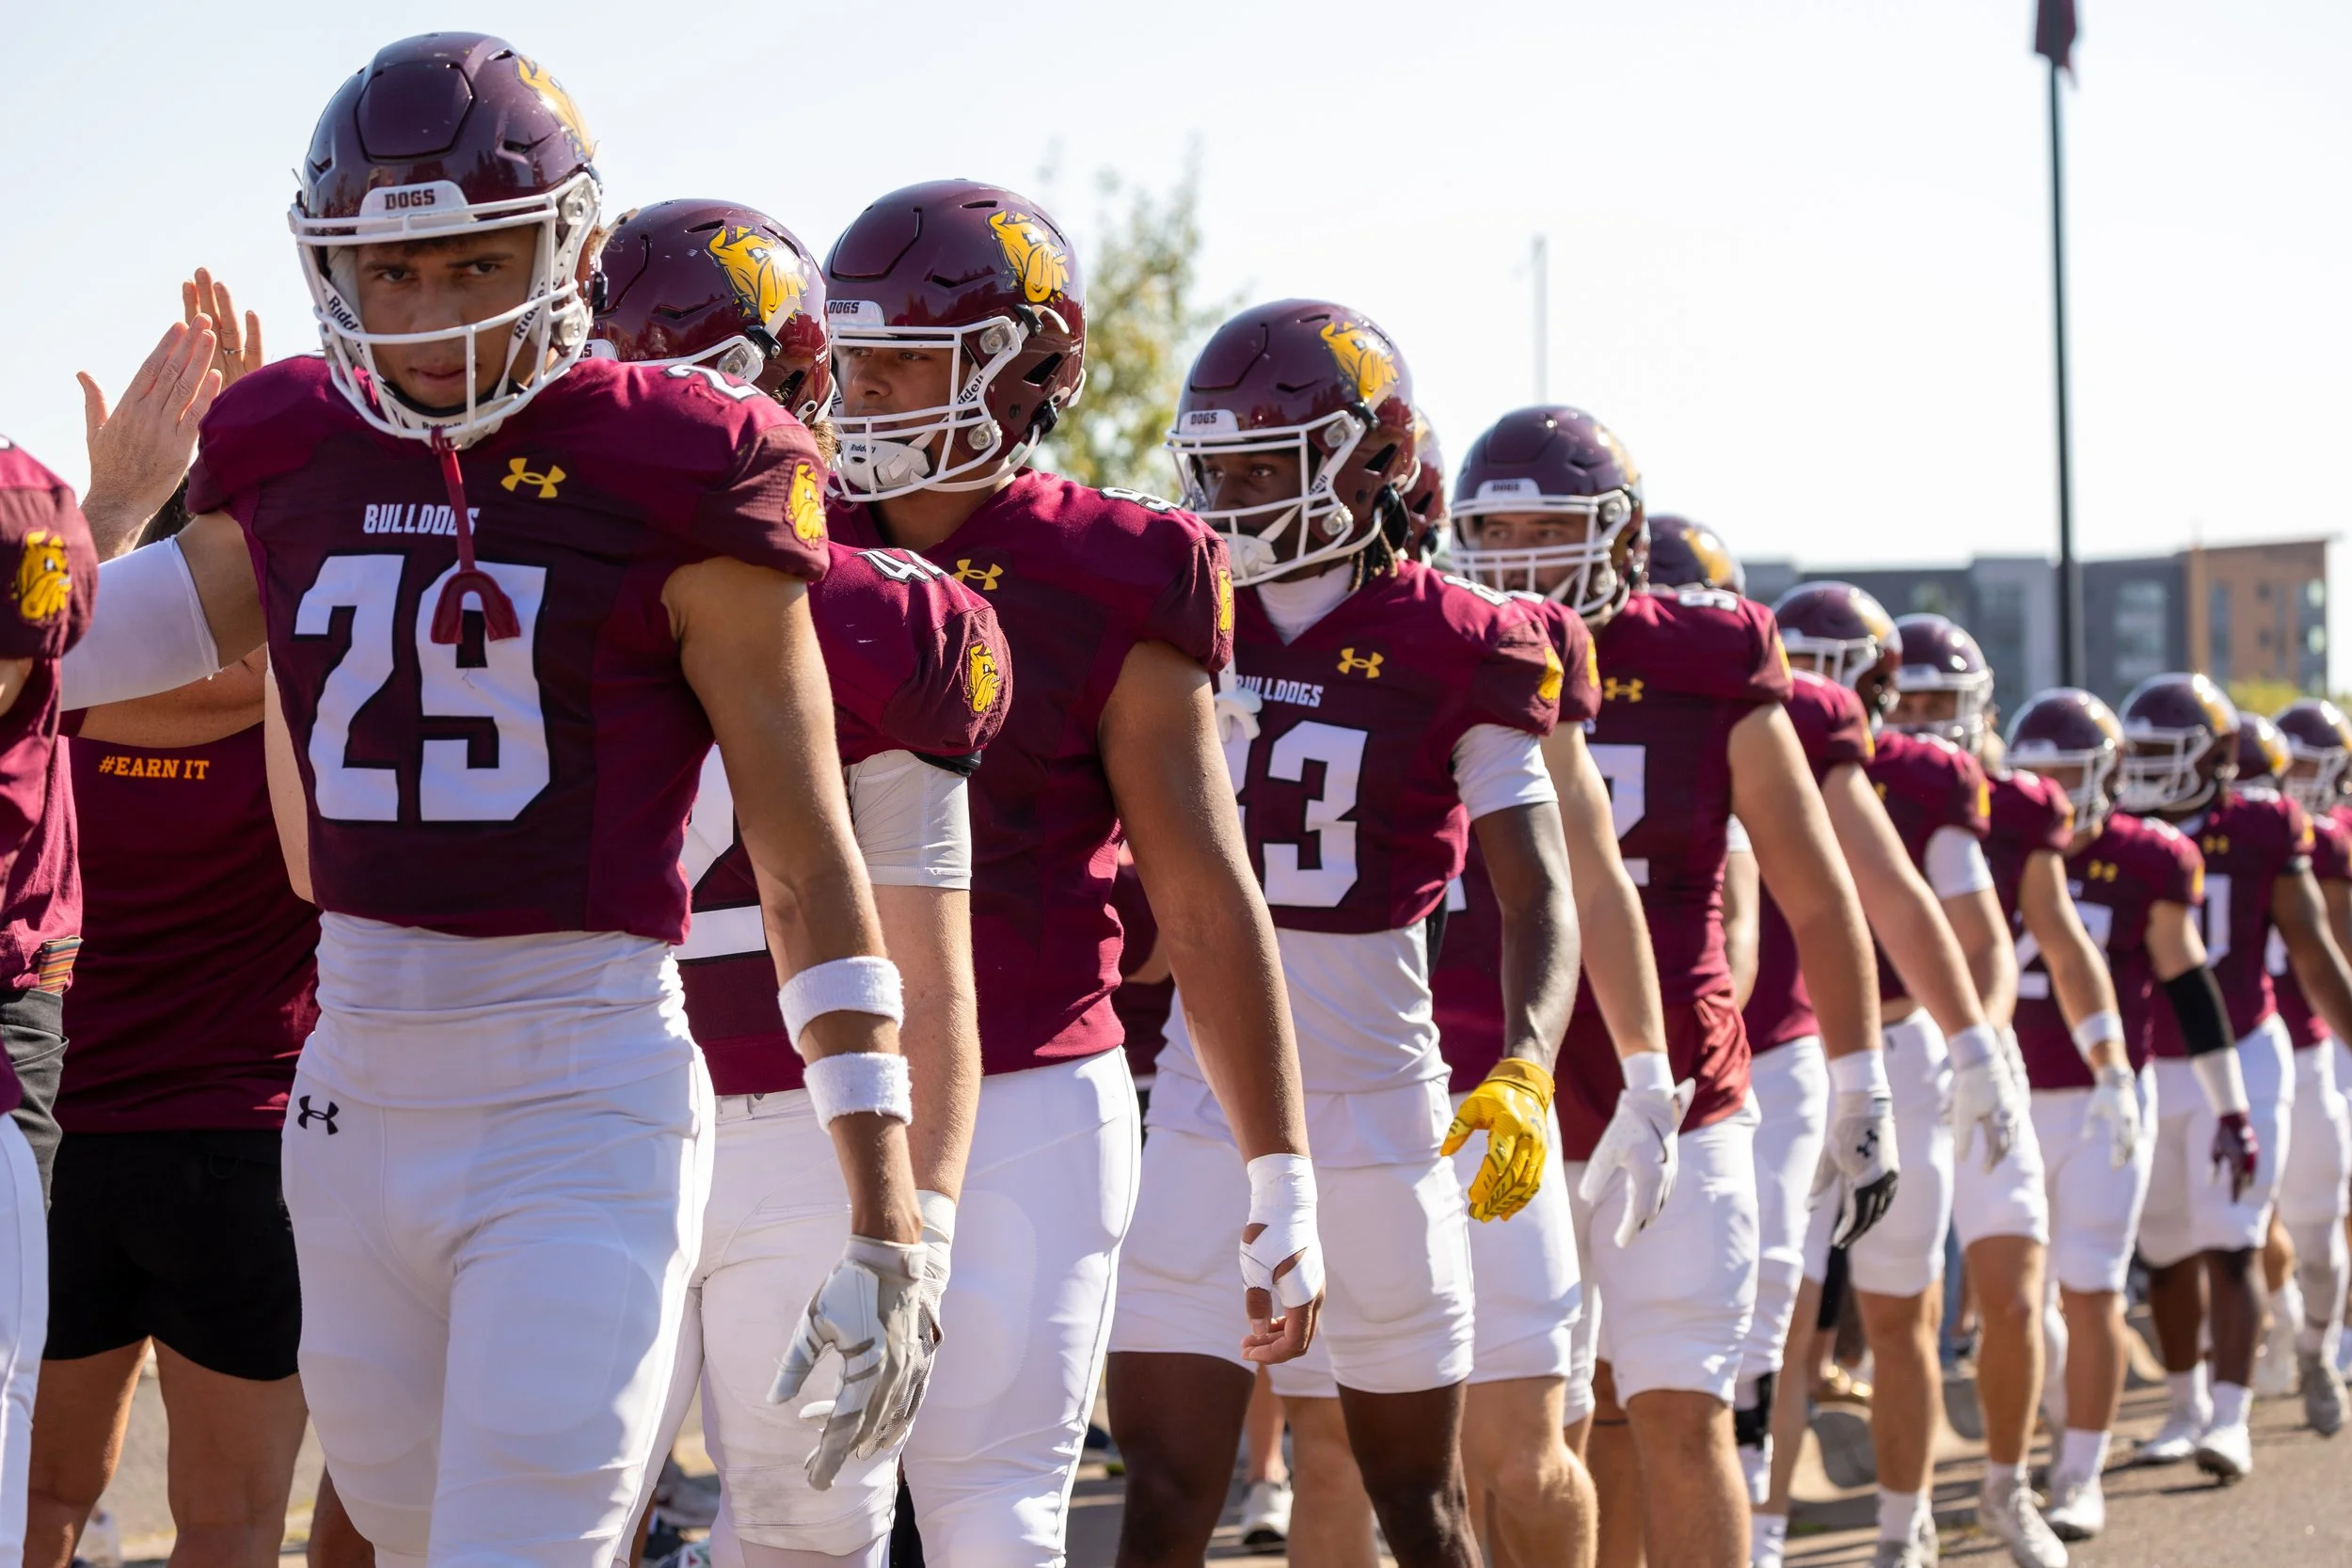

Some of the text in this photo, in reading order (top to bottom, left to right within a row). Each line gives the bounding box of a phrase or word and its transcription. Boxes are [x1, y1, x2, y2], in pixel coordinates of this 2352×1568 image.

[385, 188, 436, 211] DOGS
[829, 301, 860, 314] DOGS
[1190, 412, 1217, 425] DOGS
[294, 553, 551, 822] 29
[99, 755, 210, 780] #EARN IT
